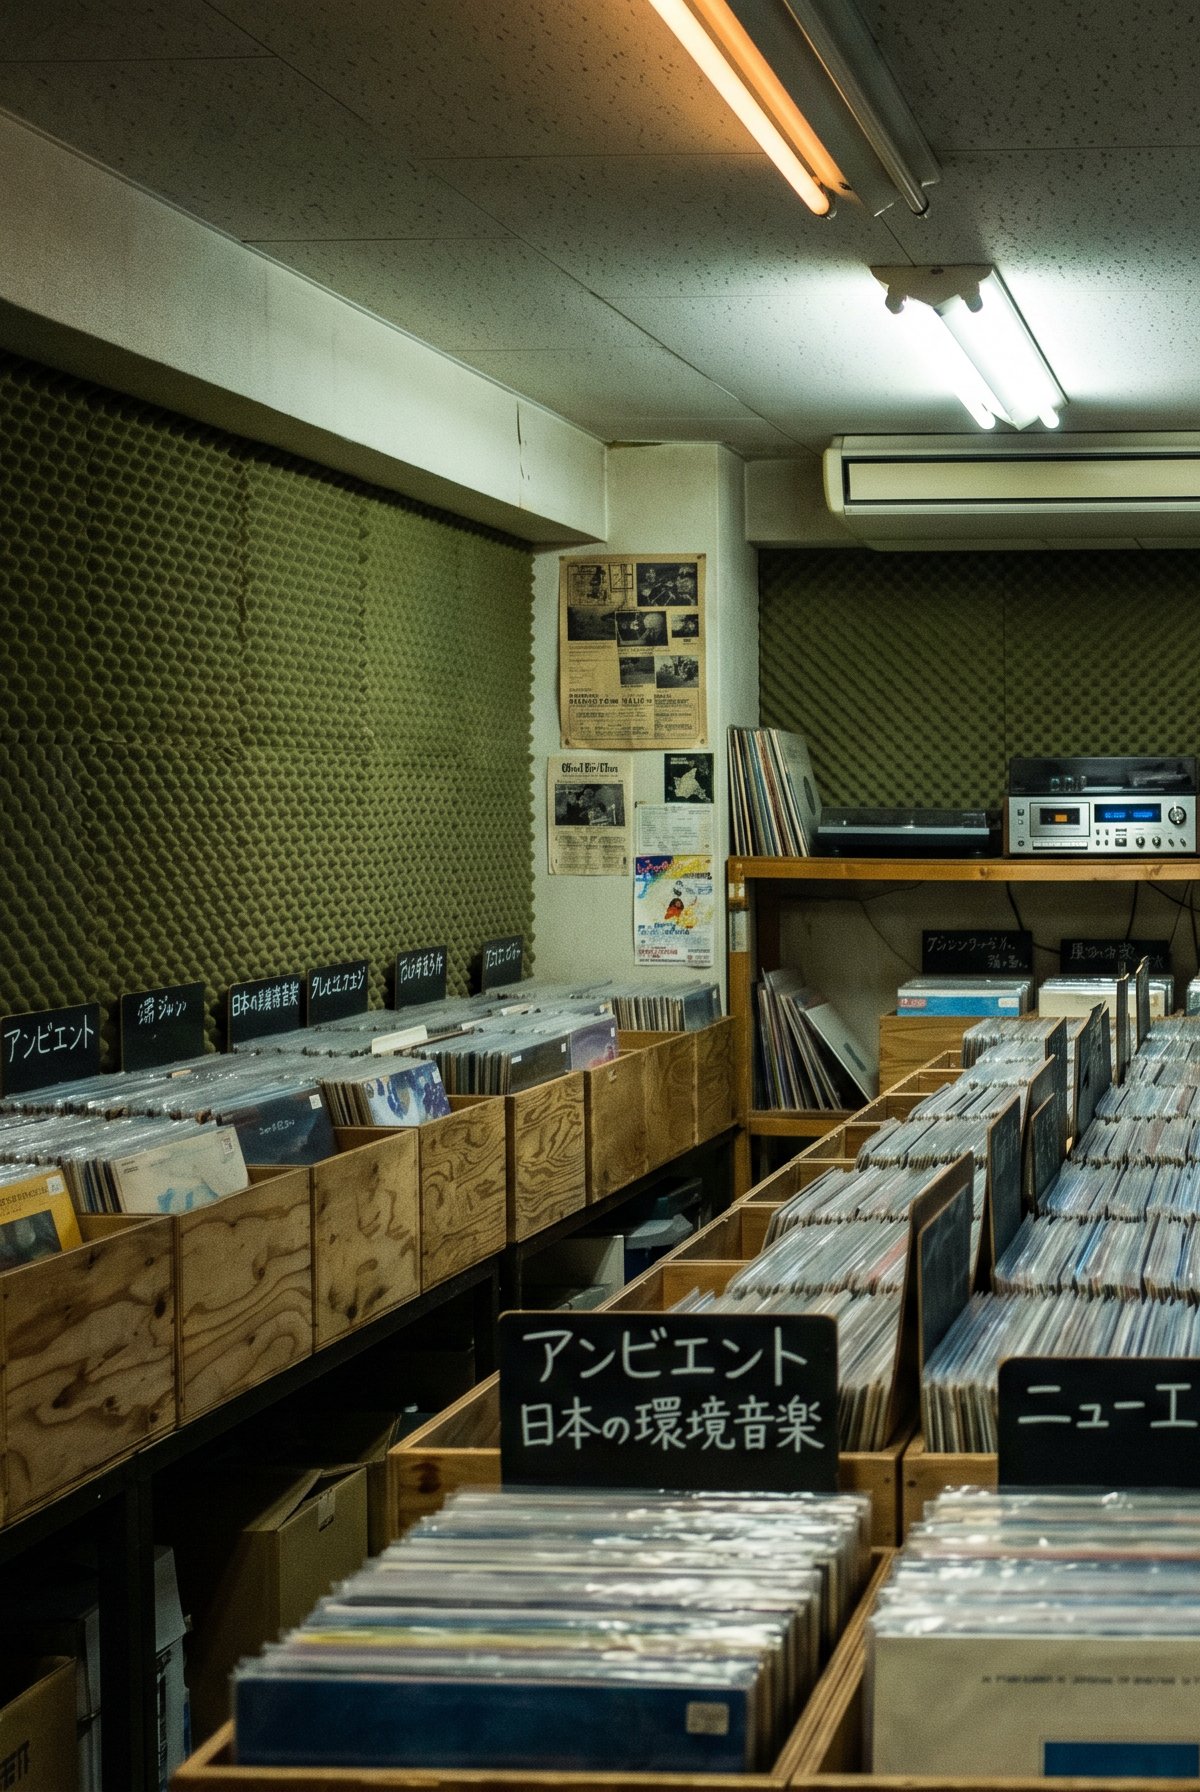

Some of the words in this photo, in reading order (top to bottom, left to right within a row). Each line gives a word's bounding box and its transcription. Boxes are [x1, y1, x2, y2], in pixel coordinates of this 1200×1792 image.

[4, 1014, 94, 1063] アンビエント
[523, 1326, 807, 1386] アンビエント
[521, 1396, 825, 1453] 日本の環境音楽
